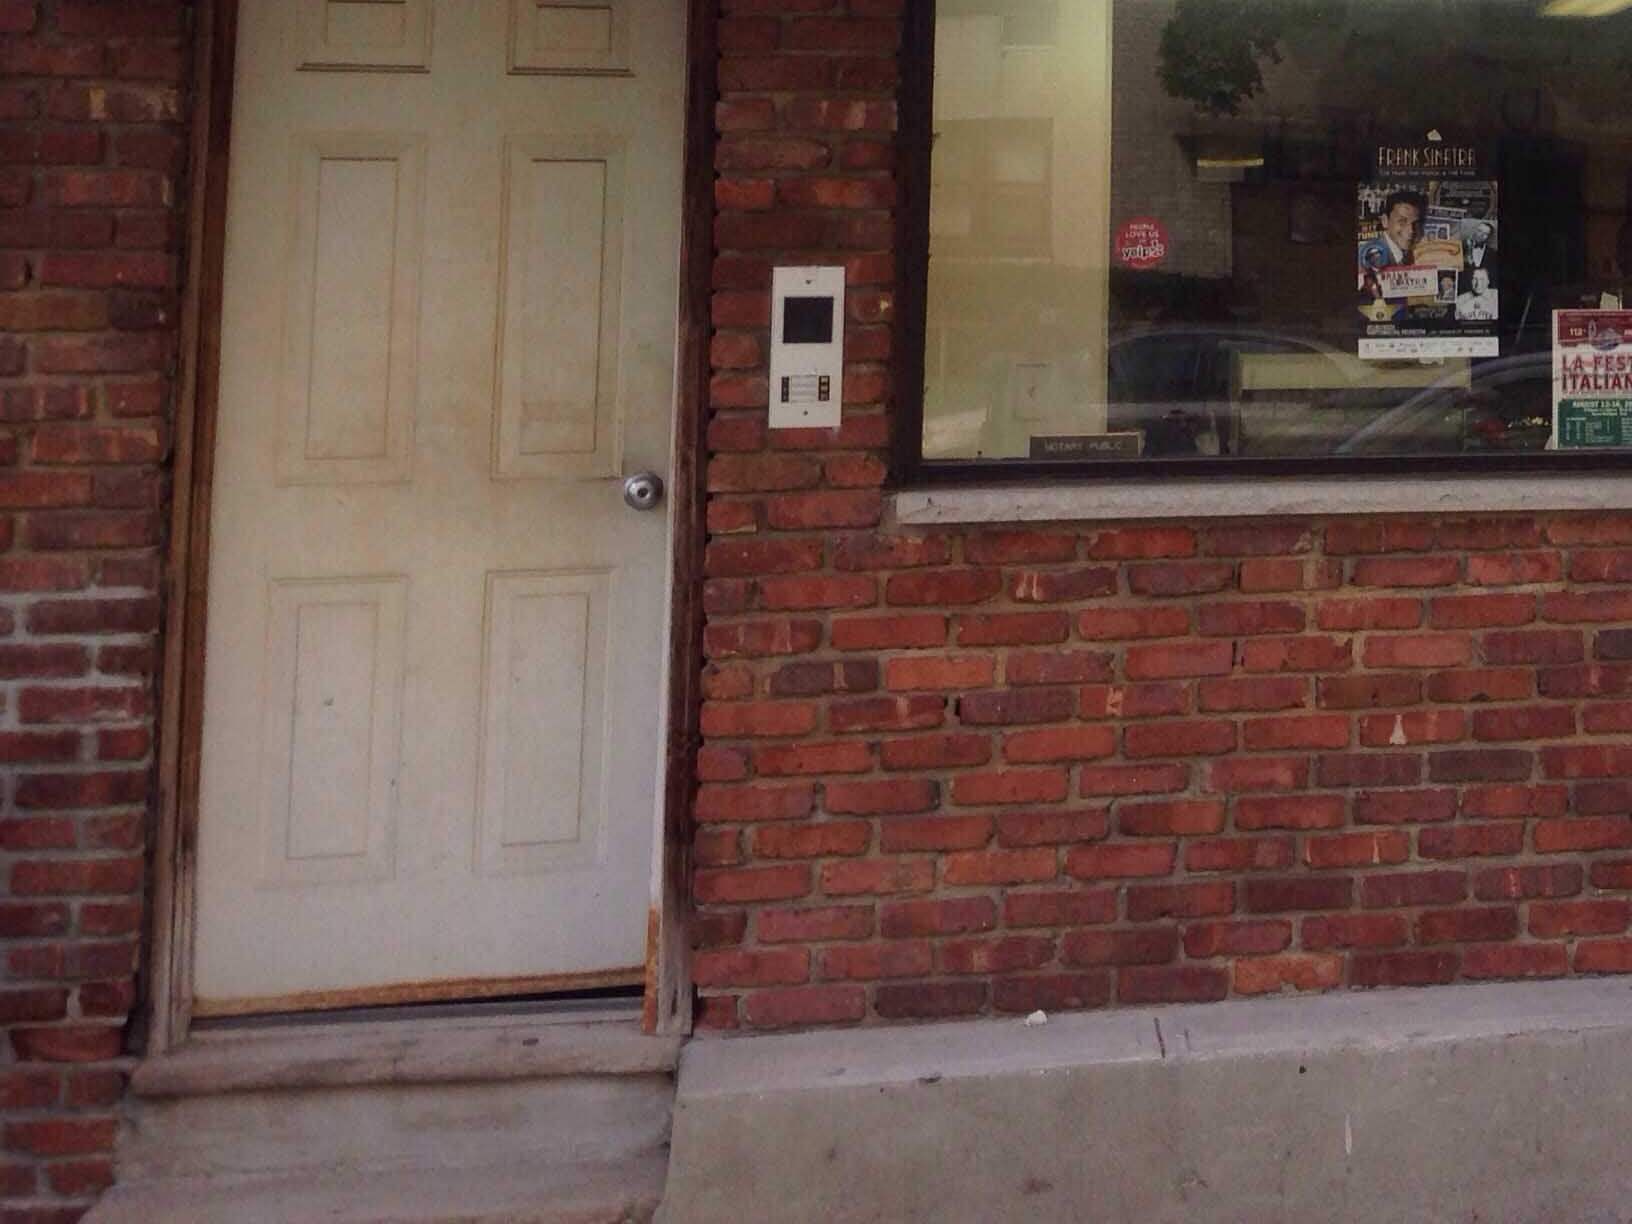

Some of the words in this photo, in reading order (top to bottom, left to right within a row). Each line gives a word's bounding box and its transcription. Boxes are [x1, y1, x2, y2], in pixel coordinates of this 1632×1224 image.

[1379, 146, 1419, 167] FRANK
[1423, 146, 1476, 168] SINATRA
[1562, 355, 1583, 372] LA
